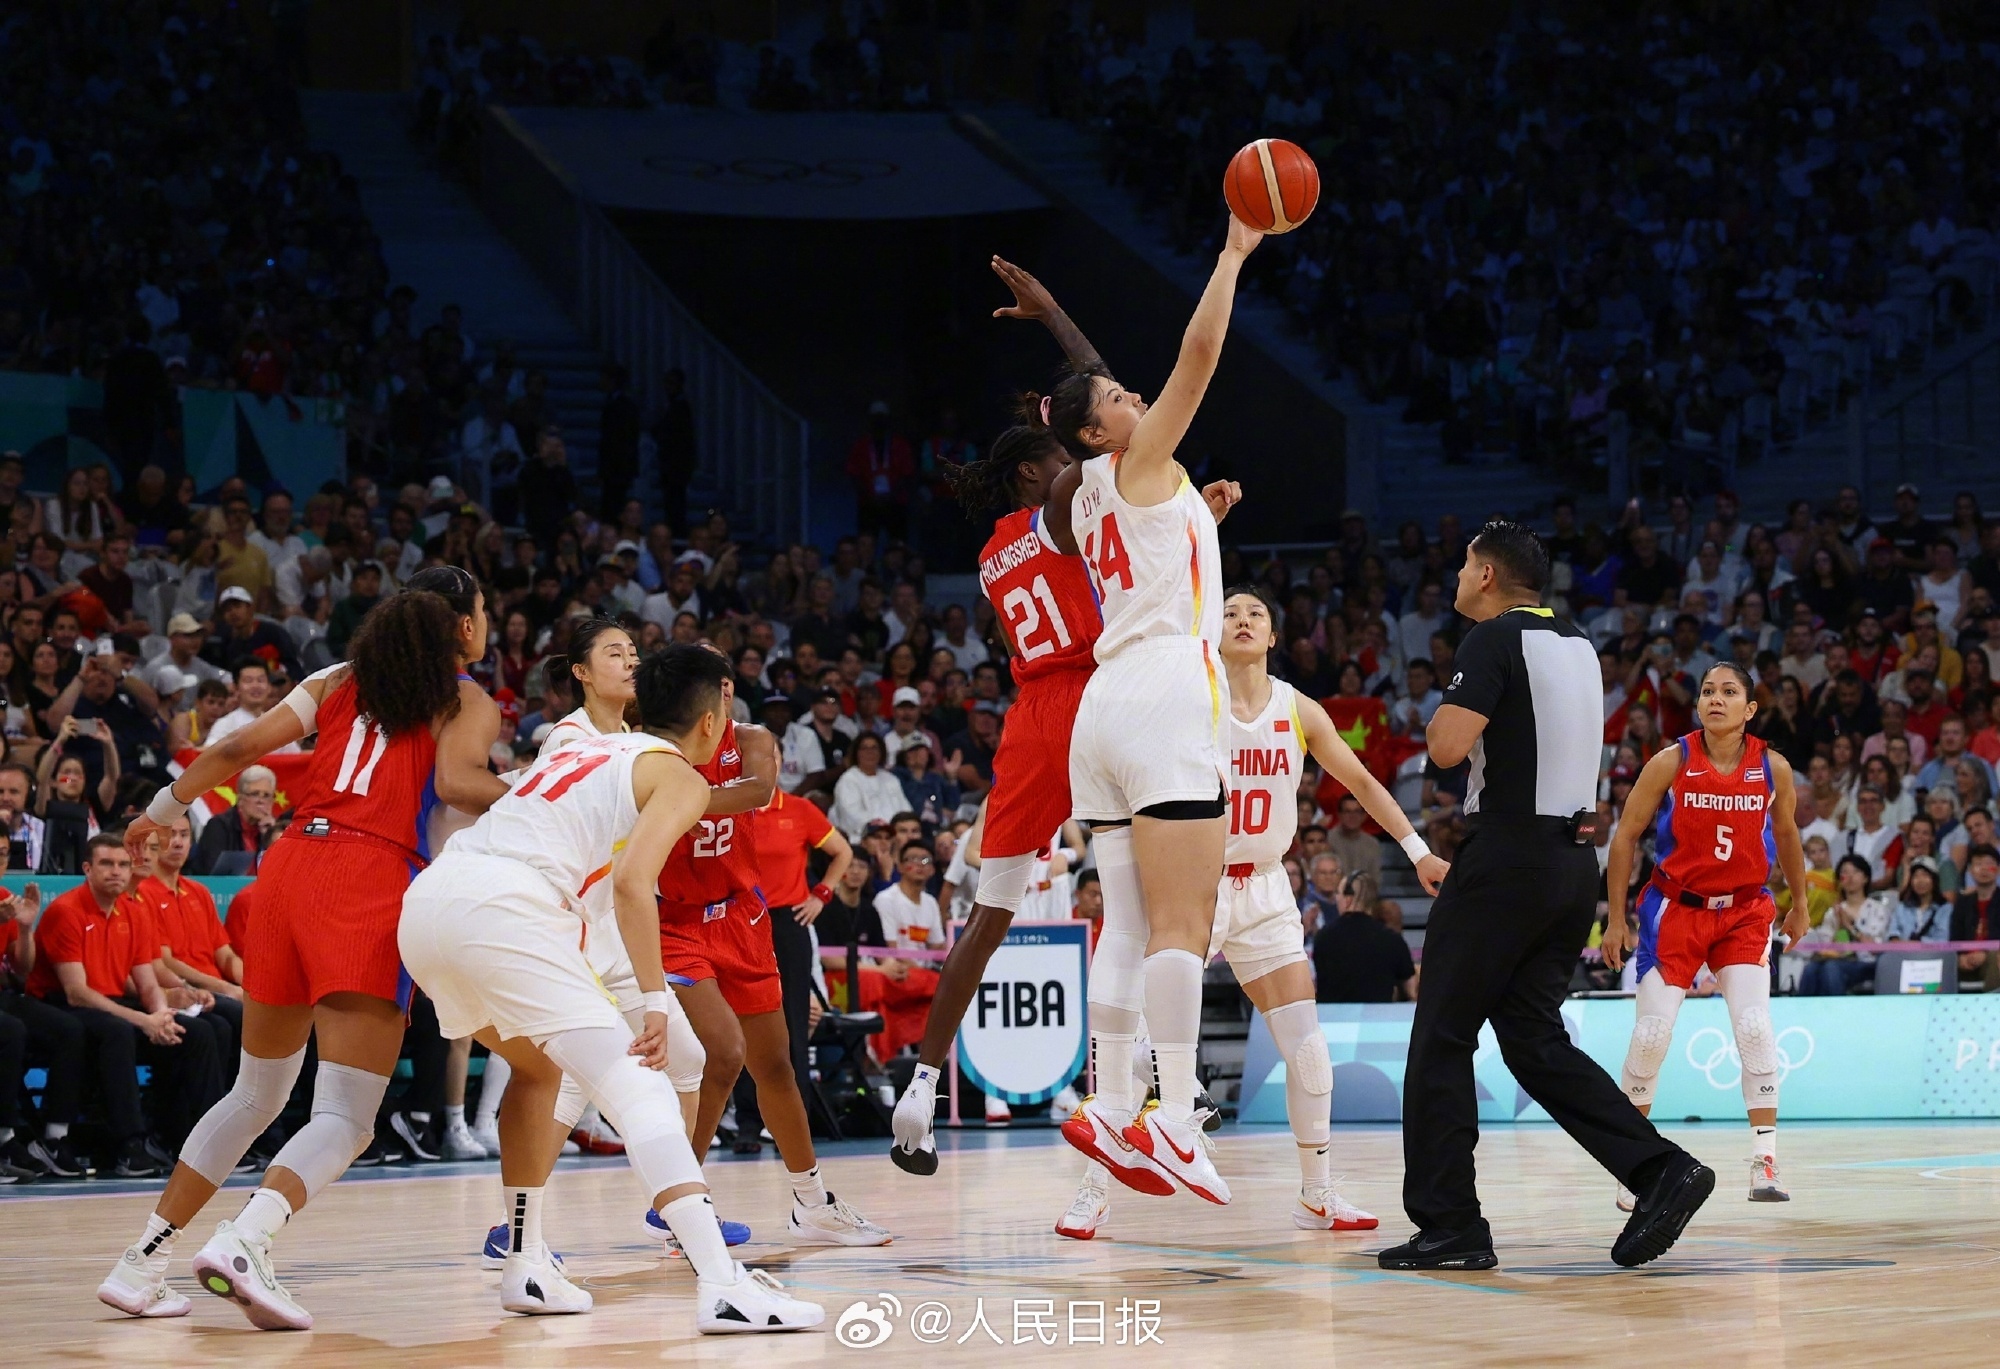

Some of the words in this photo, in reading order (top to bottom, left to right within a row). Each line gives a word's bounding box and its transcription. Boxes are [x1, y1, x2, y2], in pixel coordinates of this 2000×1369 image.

[981, 531, 1041, 586] HOLLINGSHED
[1003, 573, 1072, 662] 21
[333, 714, 390, 797] 11
[1231, 748, 1290, 776] HINA
[1229, 789, 1272, 835] 10
[1684, 792, 1733, 811] PUERTO
[1735, 794, 1764, 811] RICO
[693, 817, 734, 858] 22
[1714, 824, 1734, 862] 5
[977, 979, 1066, 1029] FIBA
